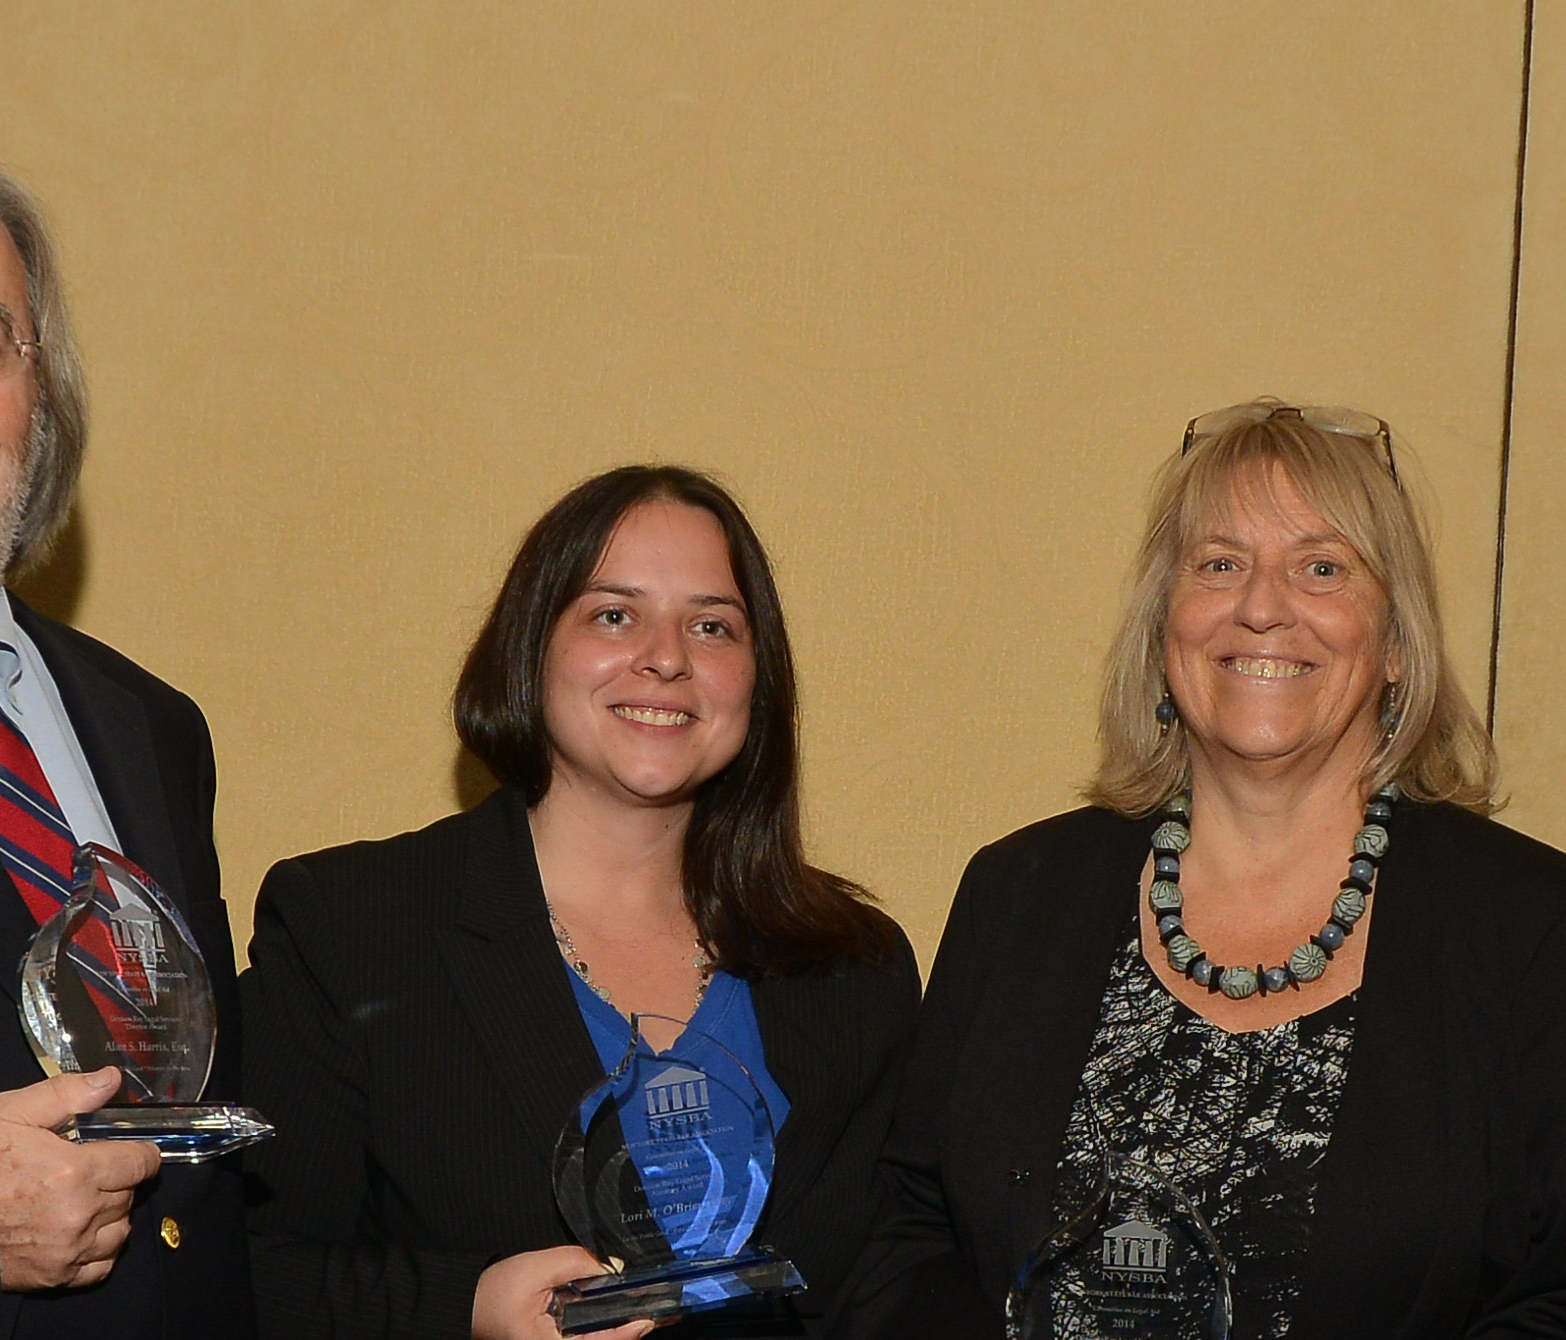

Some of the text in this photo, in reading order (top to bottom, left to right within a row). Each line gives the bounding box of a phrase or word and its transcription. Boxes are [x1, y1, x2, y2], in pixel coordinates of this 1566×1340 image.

[649, 1111, 713, 1130] NYSBA
[621, 1210, 644, 1224] Lori
[645, 1208, 661, 1219] M.
[1101, 1271, 1167, 1284] NYSBA
[1112, 1318, 1136, 1329] 2014
